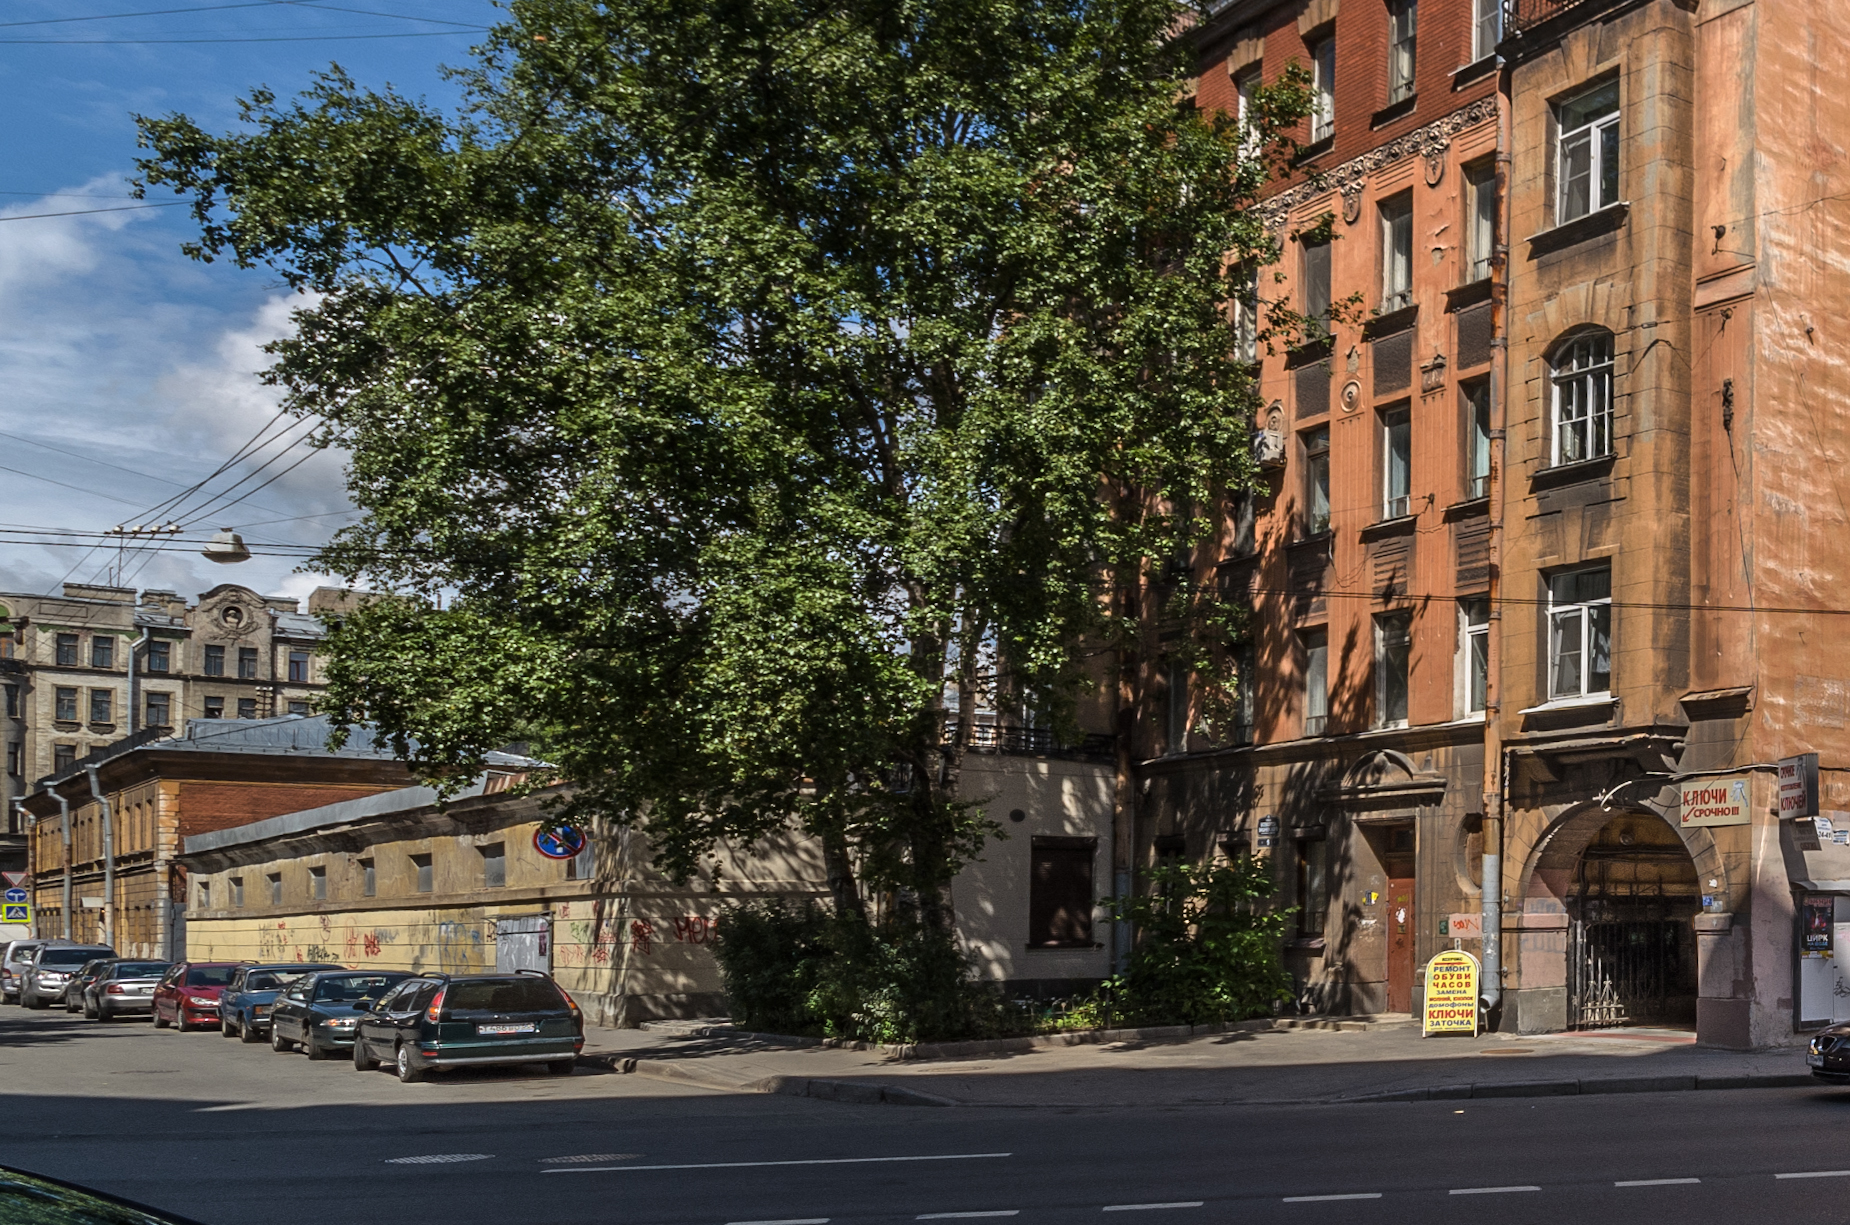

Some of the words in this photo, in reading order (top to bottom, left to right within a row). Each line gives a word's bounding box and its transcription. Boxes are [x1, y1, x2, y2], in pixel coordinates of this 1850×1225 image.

[1683, 788, 1727, 806] КЛЮЧИ
[1432, 981, 1471, 989] ЧАСОВ
[1428, 1009, 1474, 1019] КЛЮЧИ
[1429, 1019, 1472, 1027] ЗАТОЧКА
